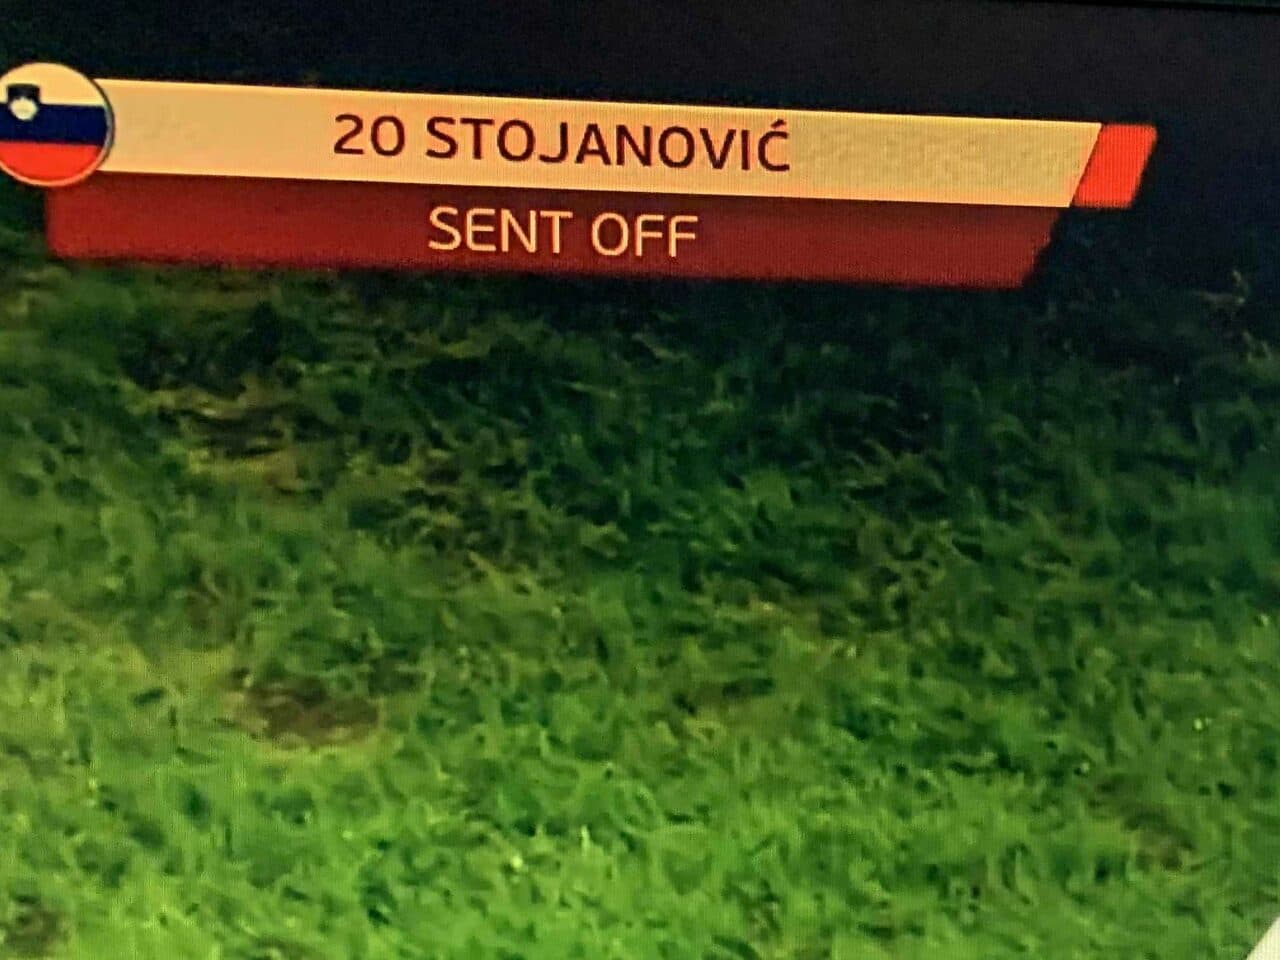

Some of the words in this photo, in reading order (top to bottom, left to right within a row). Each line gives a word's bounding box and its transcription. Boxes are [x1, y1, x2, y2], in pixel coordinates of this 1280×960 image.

[332, 113, 405, 157] 20
[425, 116, 791, 173] STOJANOVIĆ
[428, 205, 573, 254] SENT
[590, 211, 699, 258] OFF
